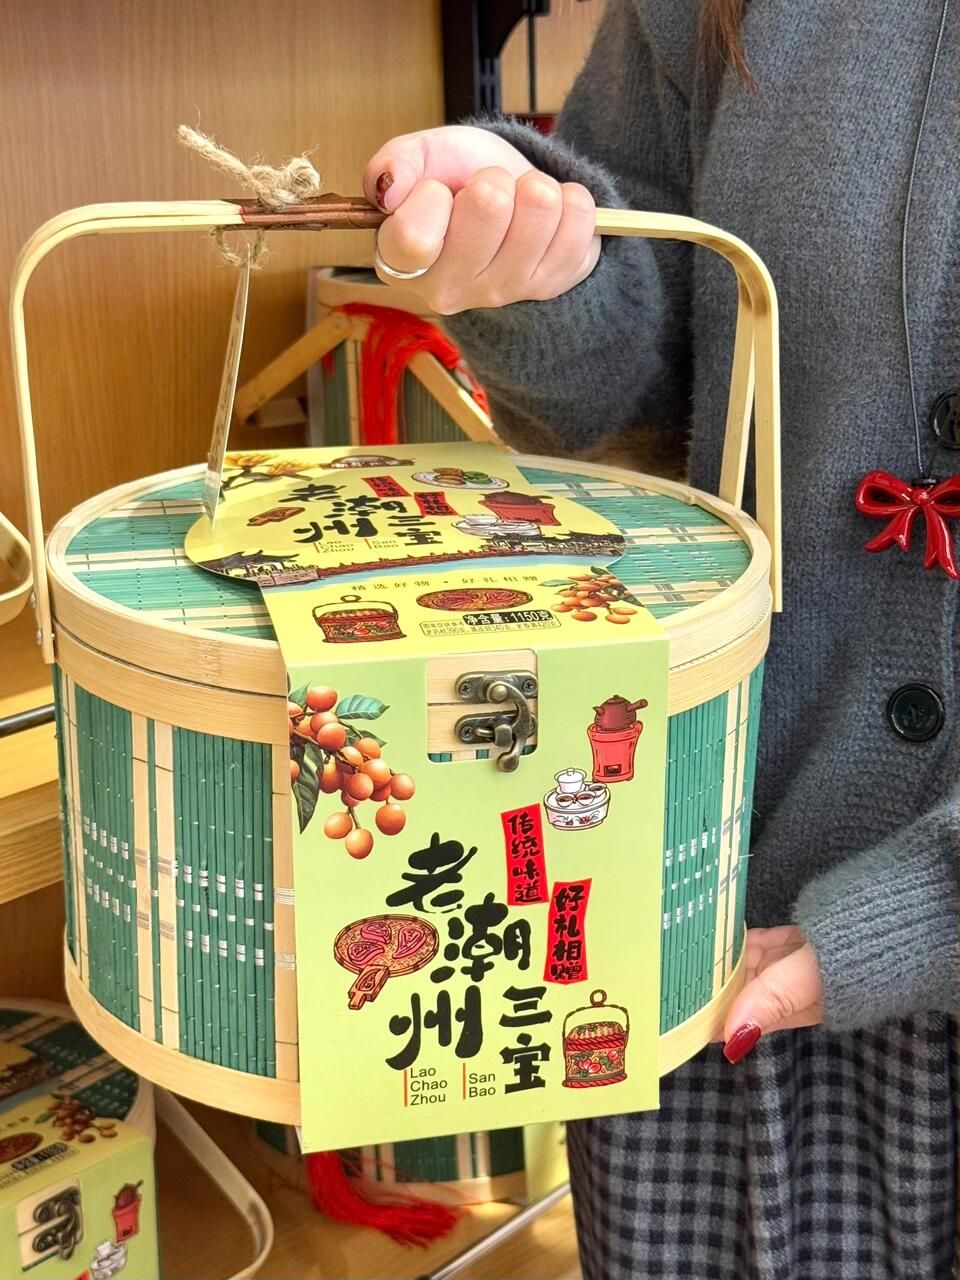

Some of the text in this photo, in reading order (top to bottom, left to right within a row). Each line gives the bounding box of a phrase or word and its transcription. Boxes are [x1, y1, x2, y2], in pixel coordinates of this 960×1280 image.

[506, 811, 543, 903] 传统味道
[549, 884, 585, 982] 好礼相赠
[410, 1066, 437, 1079] Lao
[468, 1072, 496, 1085] San
[410, 1079, 448, 1093] Chao
[468, 1085, 496, 1098] Bao
[409, 1092, 447, 1106] Zhou
